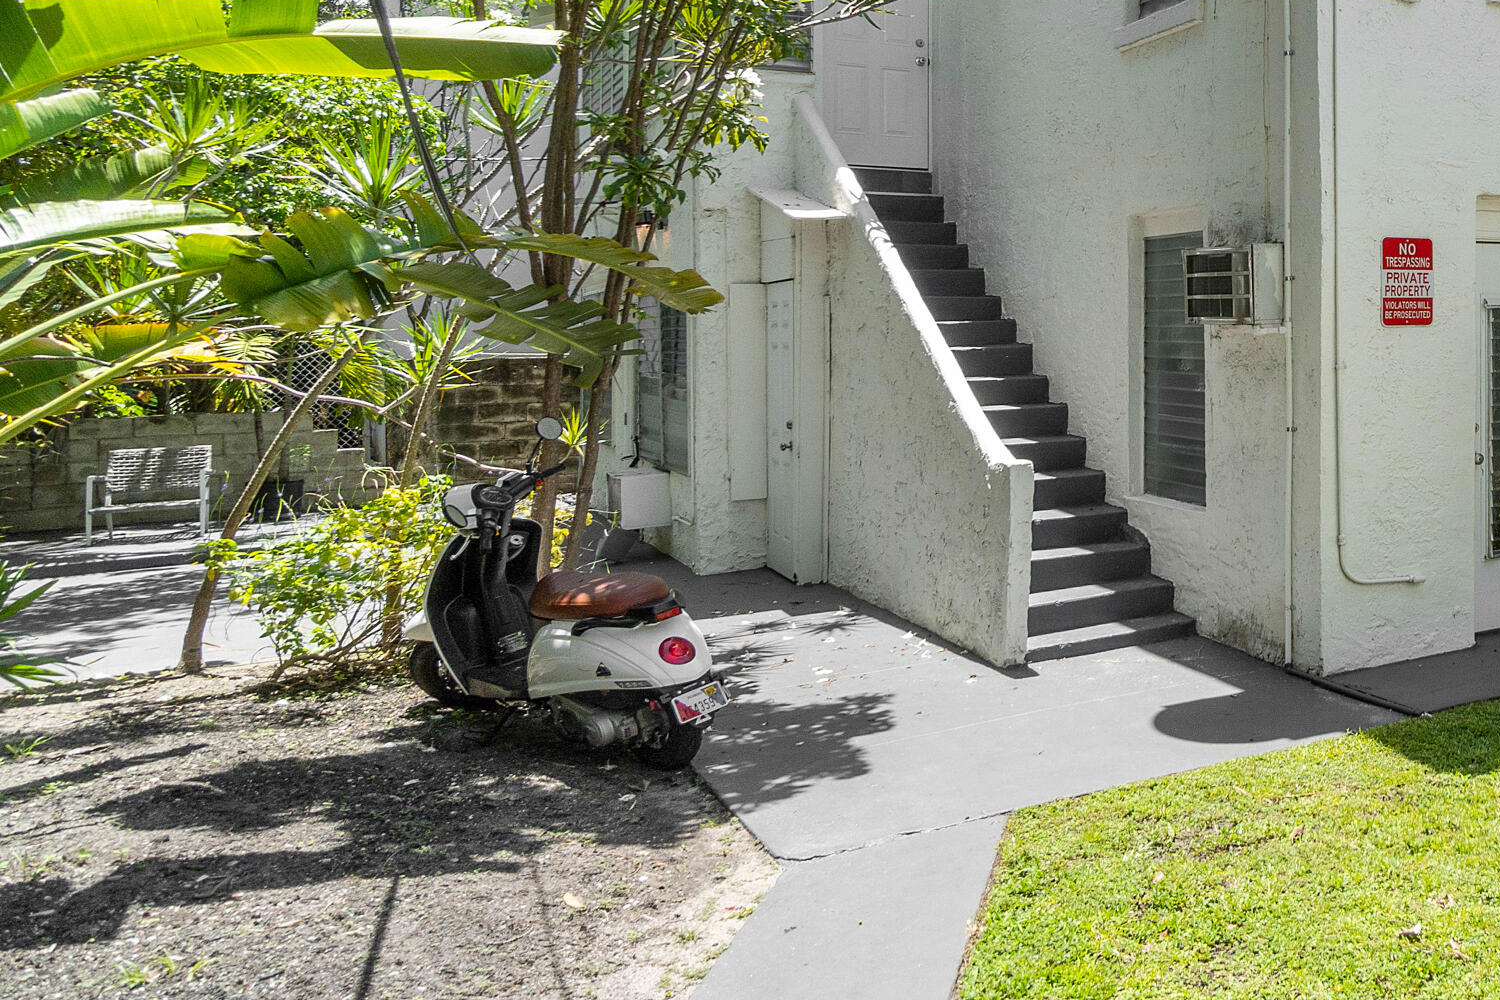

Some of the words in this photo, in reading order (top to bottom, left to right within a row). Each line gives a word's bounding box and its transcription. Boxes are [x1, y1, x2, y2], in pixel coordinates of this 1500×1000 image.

[1399, 243, 1416, 255] NO
[1385, 256, 1430, 268] TRESPASSING
[1386, 272, 1429, 284] PRIVATE
[1385, 285, 1431, 297] PROPERTY
[1385, 300, 1417, 310] VIOLATORS
[1417, 301, 1431, 310] WILL
[1385, 310, 1393, 319] BE
[1393, 310, 1431, 319] PROSECUTED
